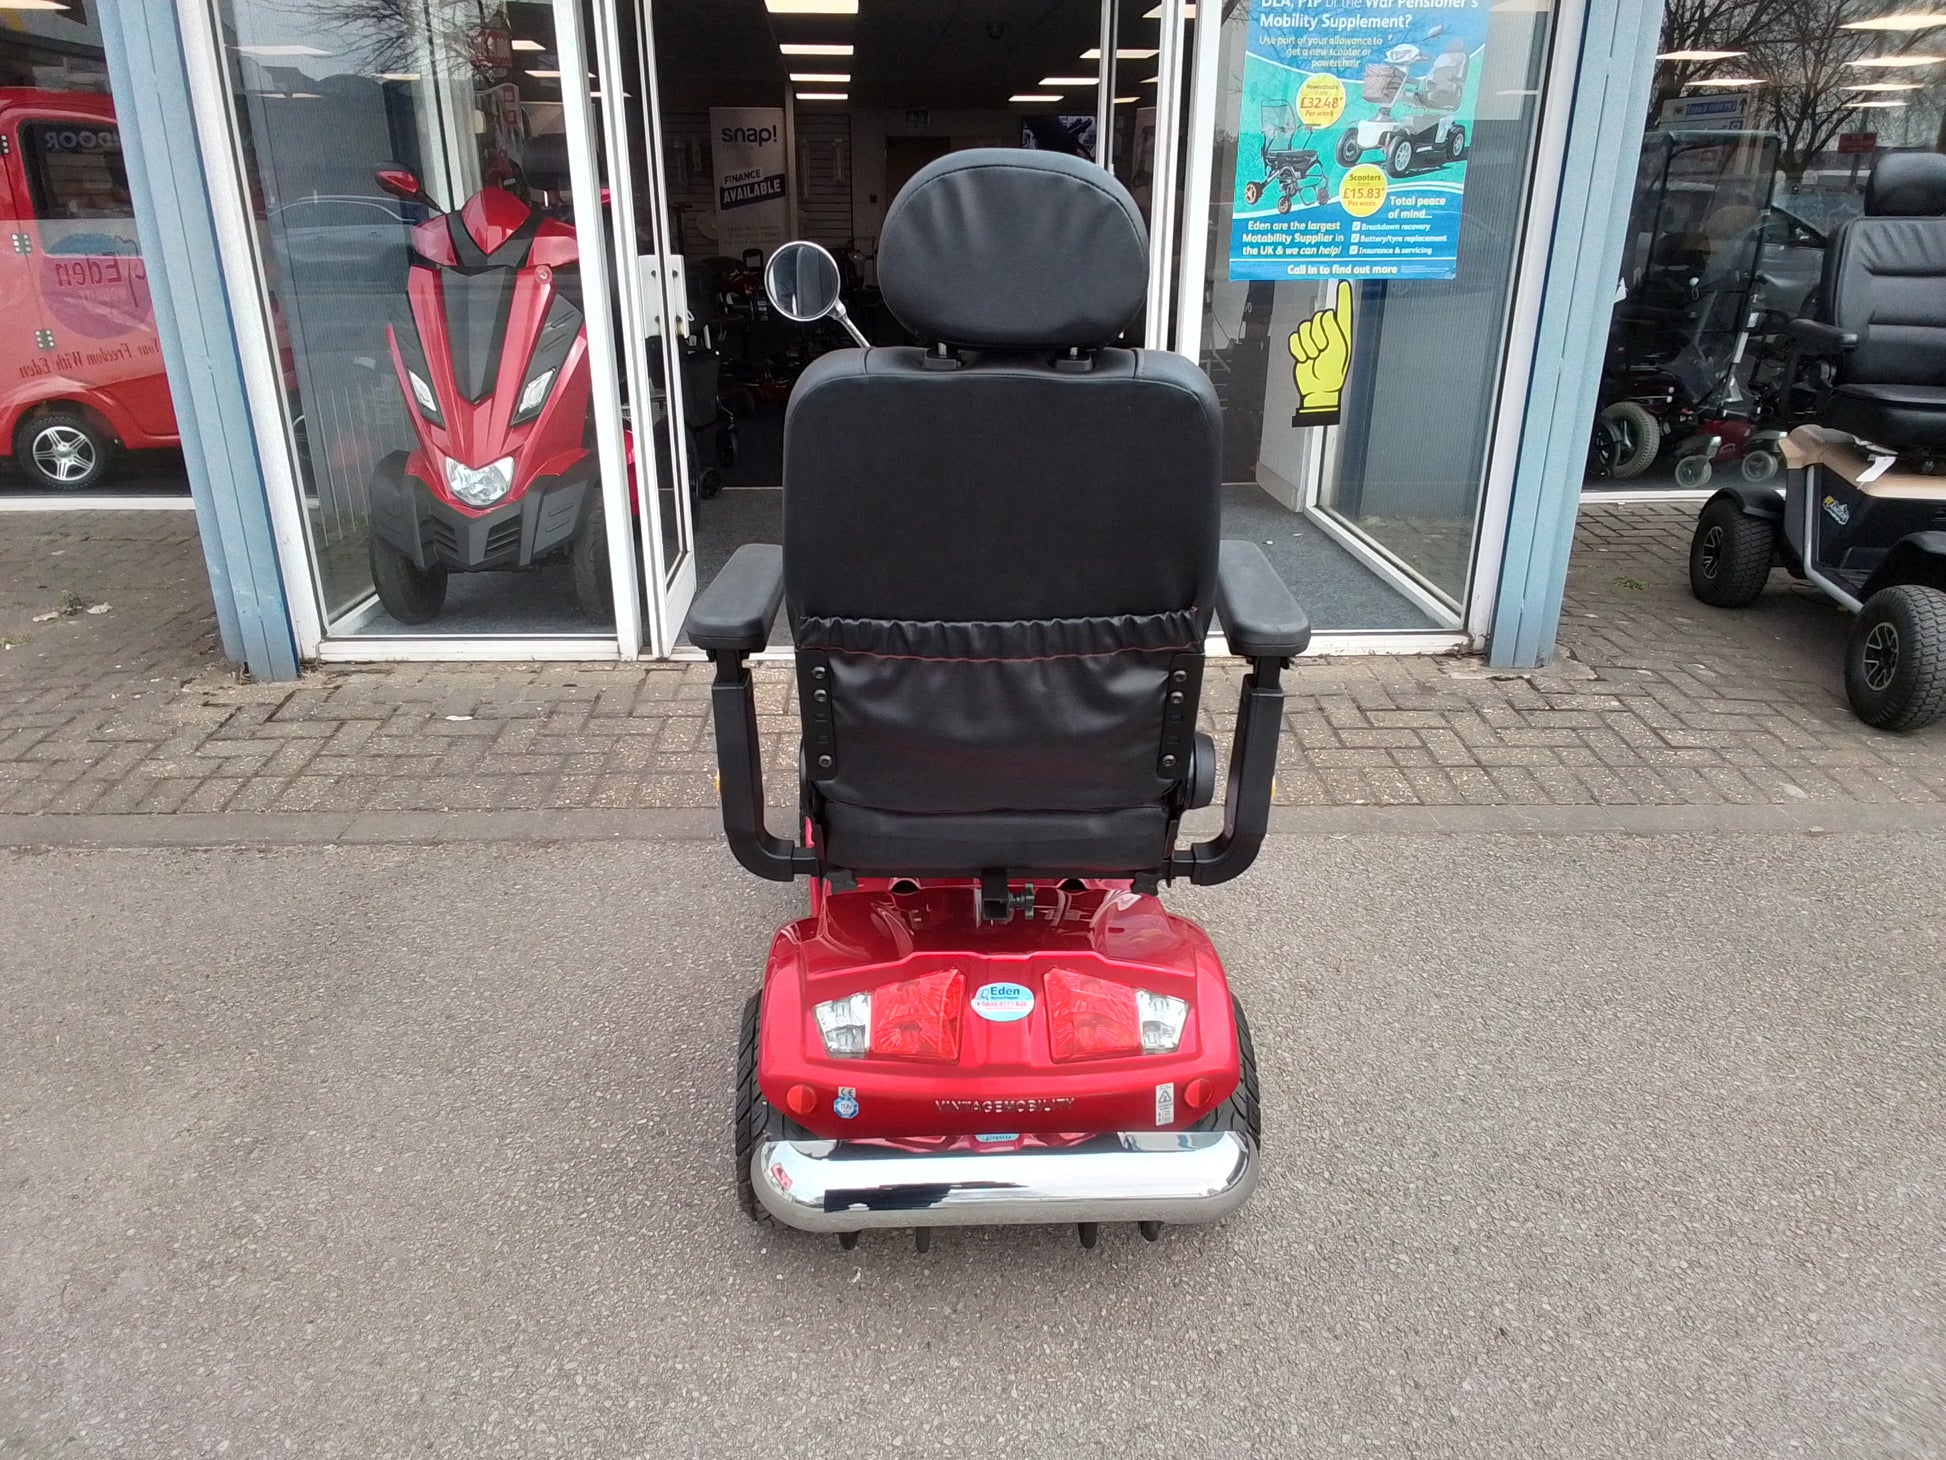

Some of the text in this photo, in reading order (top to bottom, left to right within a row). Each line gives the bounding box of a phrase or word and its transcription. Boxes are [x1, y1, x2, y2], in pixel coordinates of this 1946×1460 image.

[1261, 0, 1294, 9] DLA,
[1298, 0, 1321, 8] PIP
[1365, 0, 1393, 8] War
[1260, 13, 1412, 31] Mobility Supplement?
[1259, 34, 1383, 47] Use part of your allowance to
[1286, 48, 1300, 57] get
[1328, 47, 1360, 56] scooter
[1311, 58, 1360, 69] powerchair
[721, 124, 777, 147] snap!
[724, 169, 761, 184] FINANCE
[1349, 173, 1381, 181] Scooters
[723, 179, 782, 204] AVAILABLE
[1389, 195, 1446, 208] Total peace
[1388, 208, 1400, 219] of
[1247, 220, 1341, 232] Eden are the largest
[1401, 223, 1431, 232] recovery
[1242, 233, 1344, 245] Motability Supplier in
[1360, 234, 1447, 244] Battery/tyre replacement
[1242, 245, 1342, 257] the UK & we can help!
[1401, 246, 1433, 255] servicing
[1287, 264, 1306, 274] Call
[1307, 264, 1318, 274] in
[1319, 265, 1330, 274] to
[1332, 264, 1352, 274] find
[1353, 265, 1370, 274] out
[1372, 266, 1398, 274] more
[990, 986, 1020, 996] Eden
